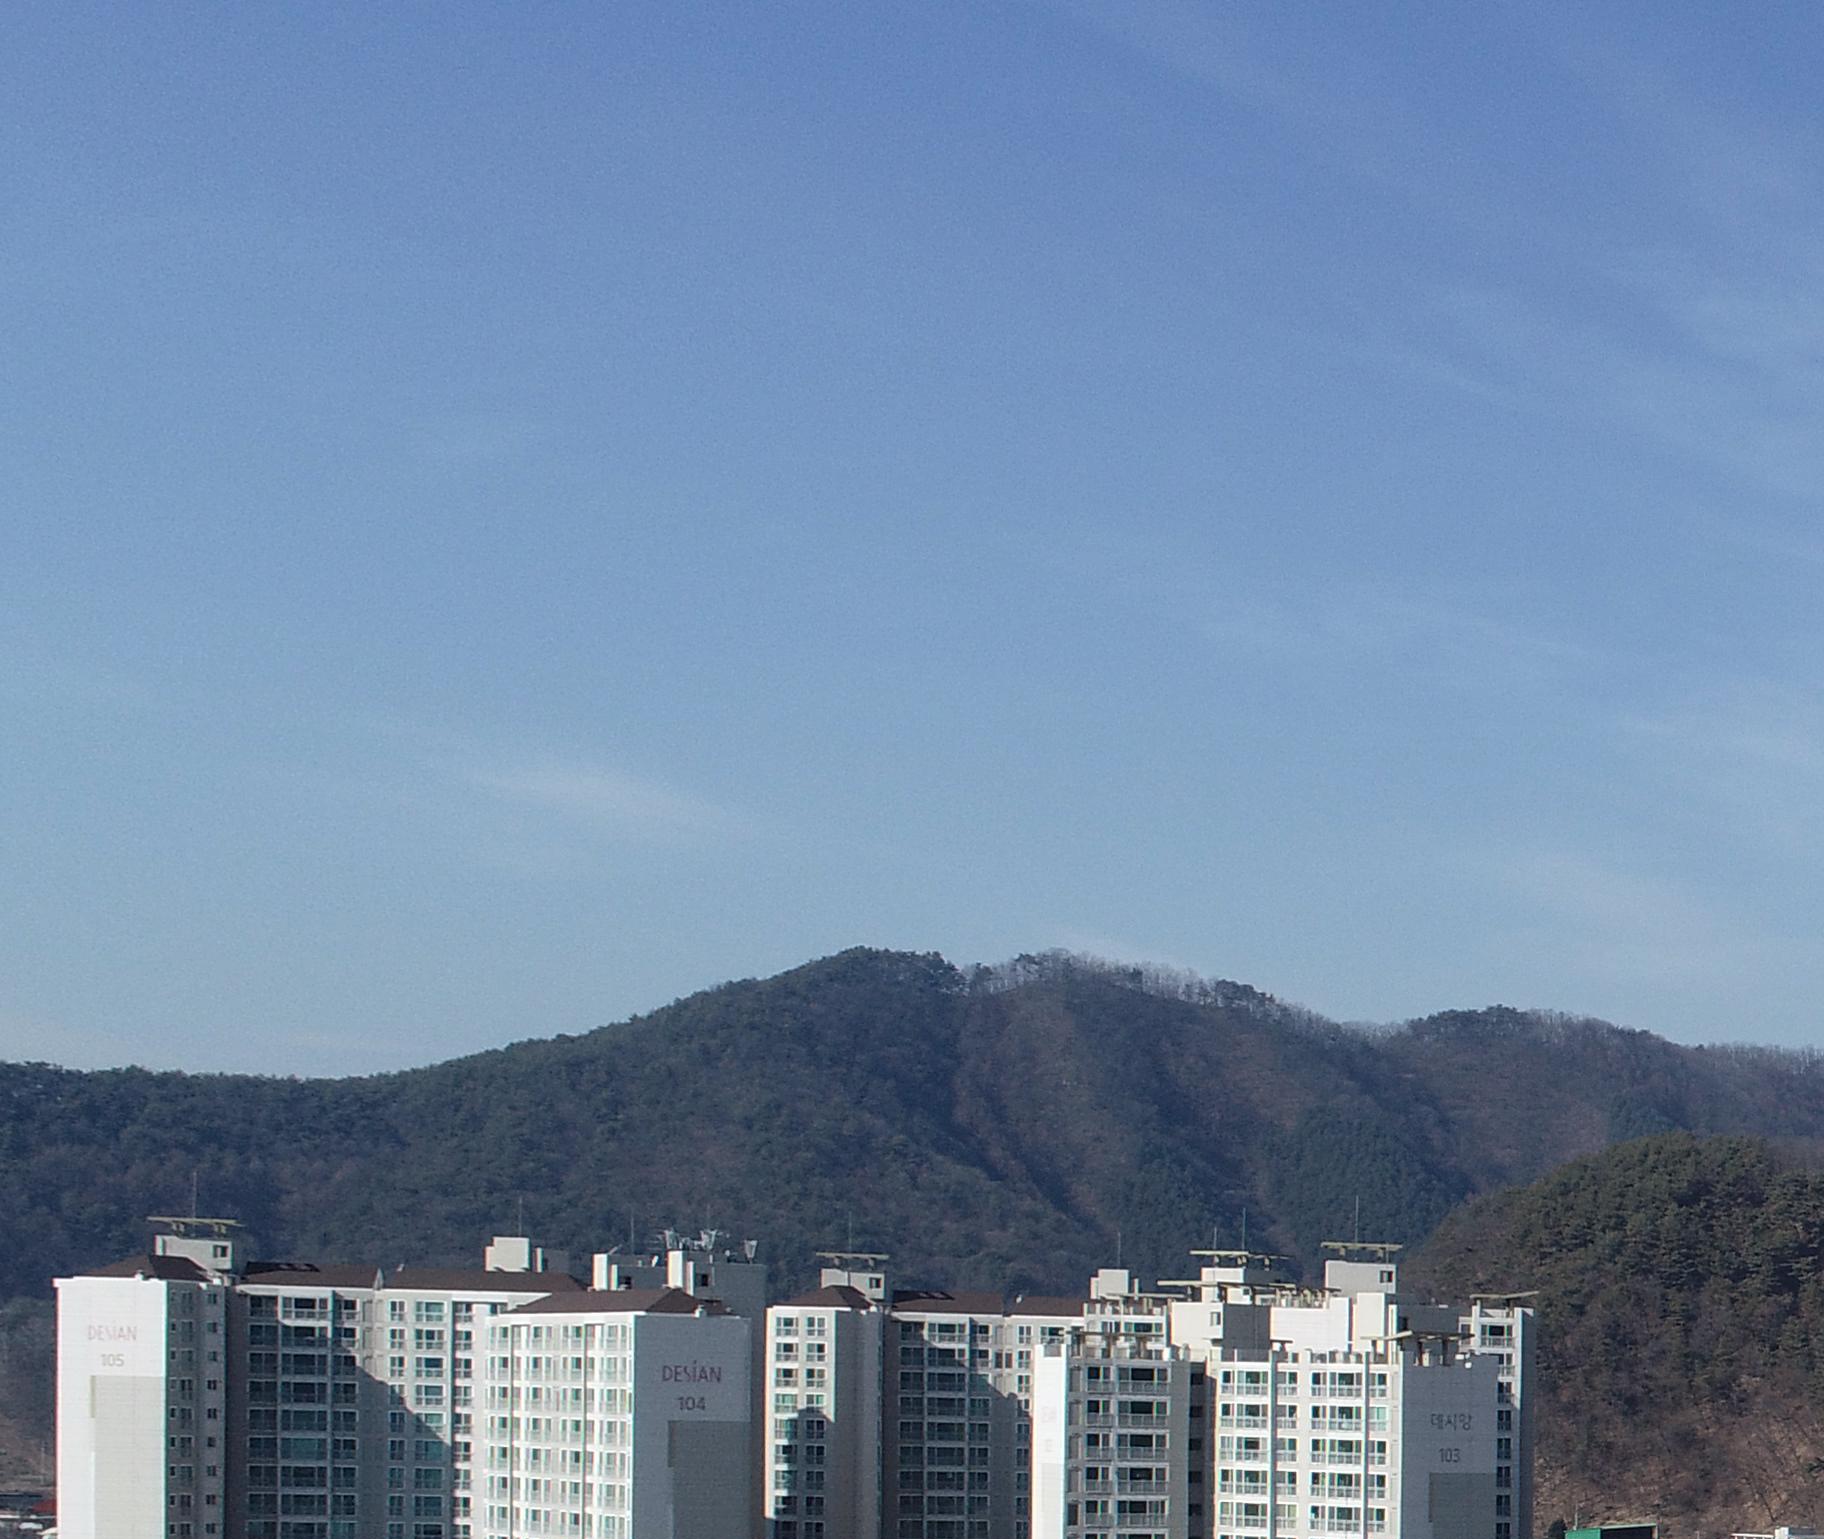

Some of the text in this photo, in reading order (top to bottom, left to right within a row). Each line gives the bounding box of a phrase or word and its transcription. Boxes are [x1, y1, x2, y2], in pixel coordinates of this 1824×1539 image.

[101, 1353, 124, 1367] 105
[678, 1396, 705, 1411] 104
[1439, 1448, 1460, 1463] 103
